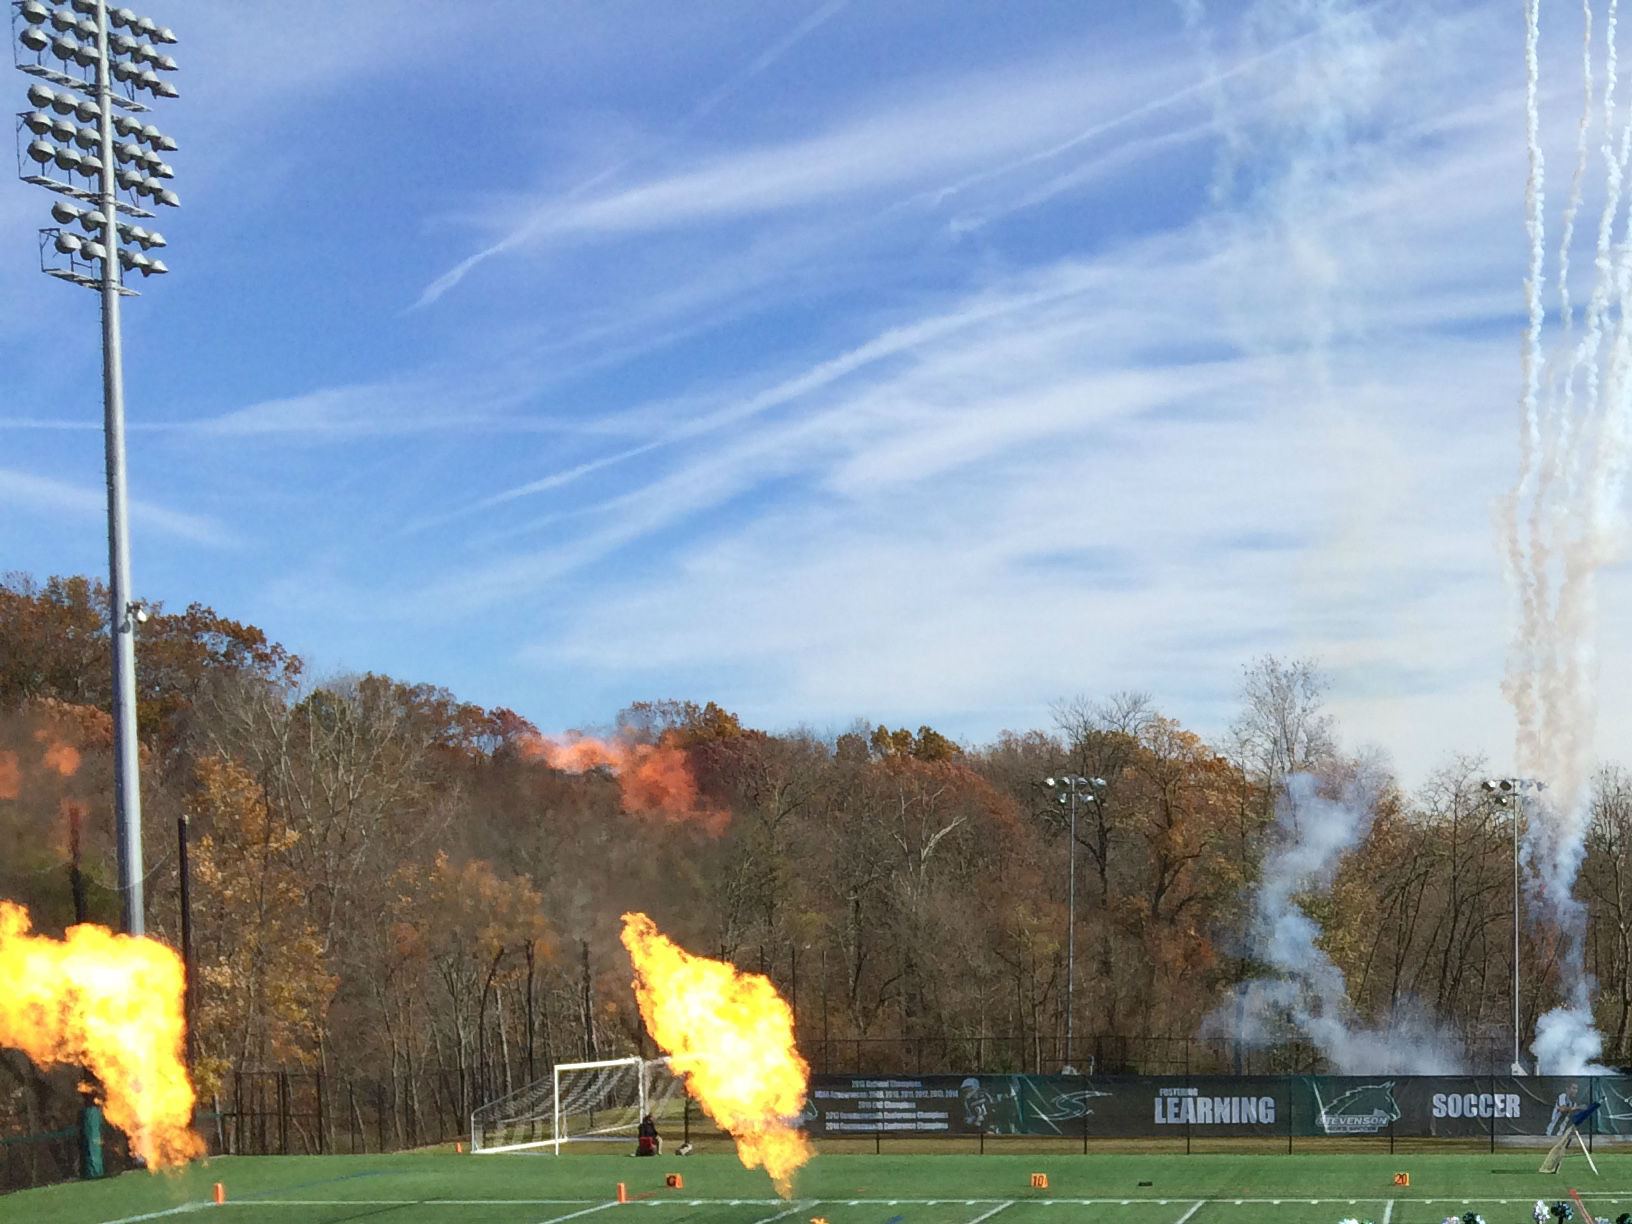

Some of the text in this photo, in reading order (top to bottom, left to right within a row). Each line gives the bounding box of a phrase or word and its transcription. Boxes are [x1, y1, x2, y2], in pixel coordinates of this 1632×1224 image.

[1154, 1097, 1276, 1124] LEARNING
[1432, 1093, 1520, 1118] SOCCER
[1033, 1175, 1044, 1187] 10
